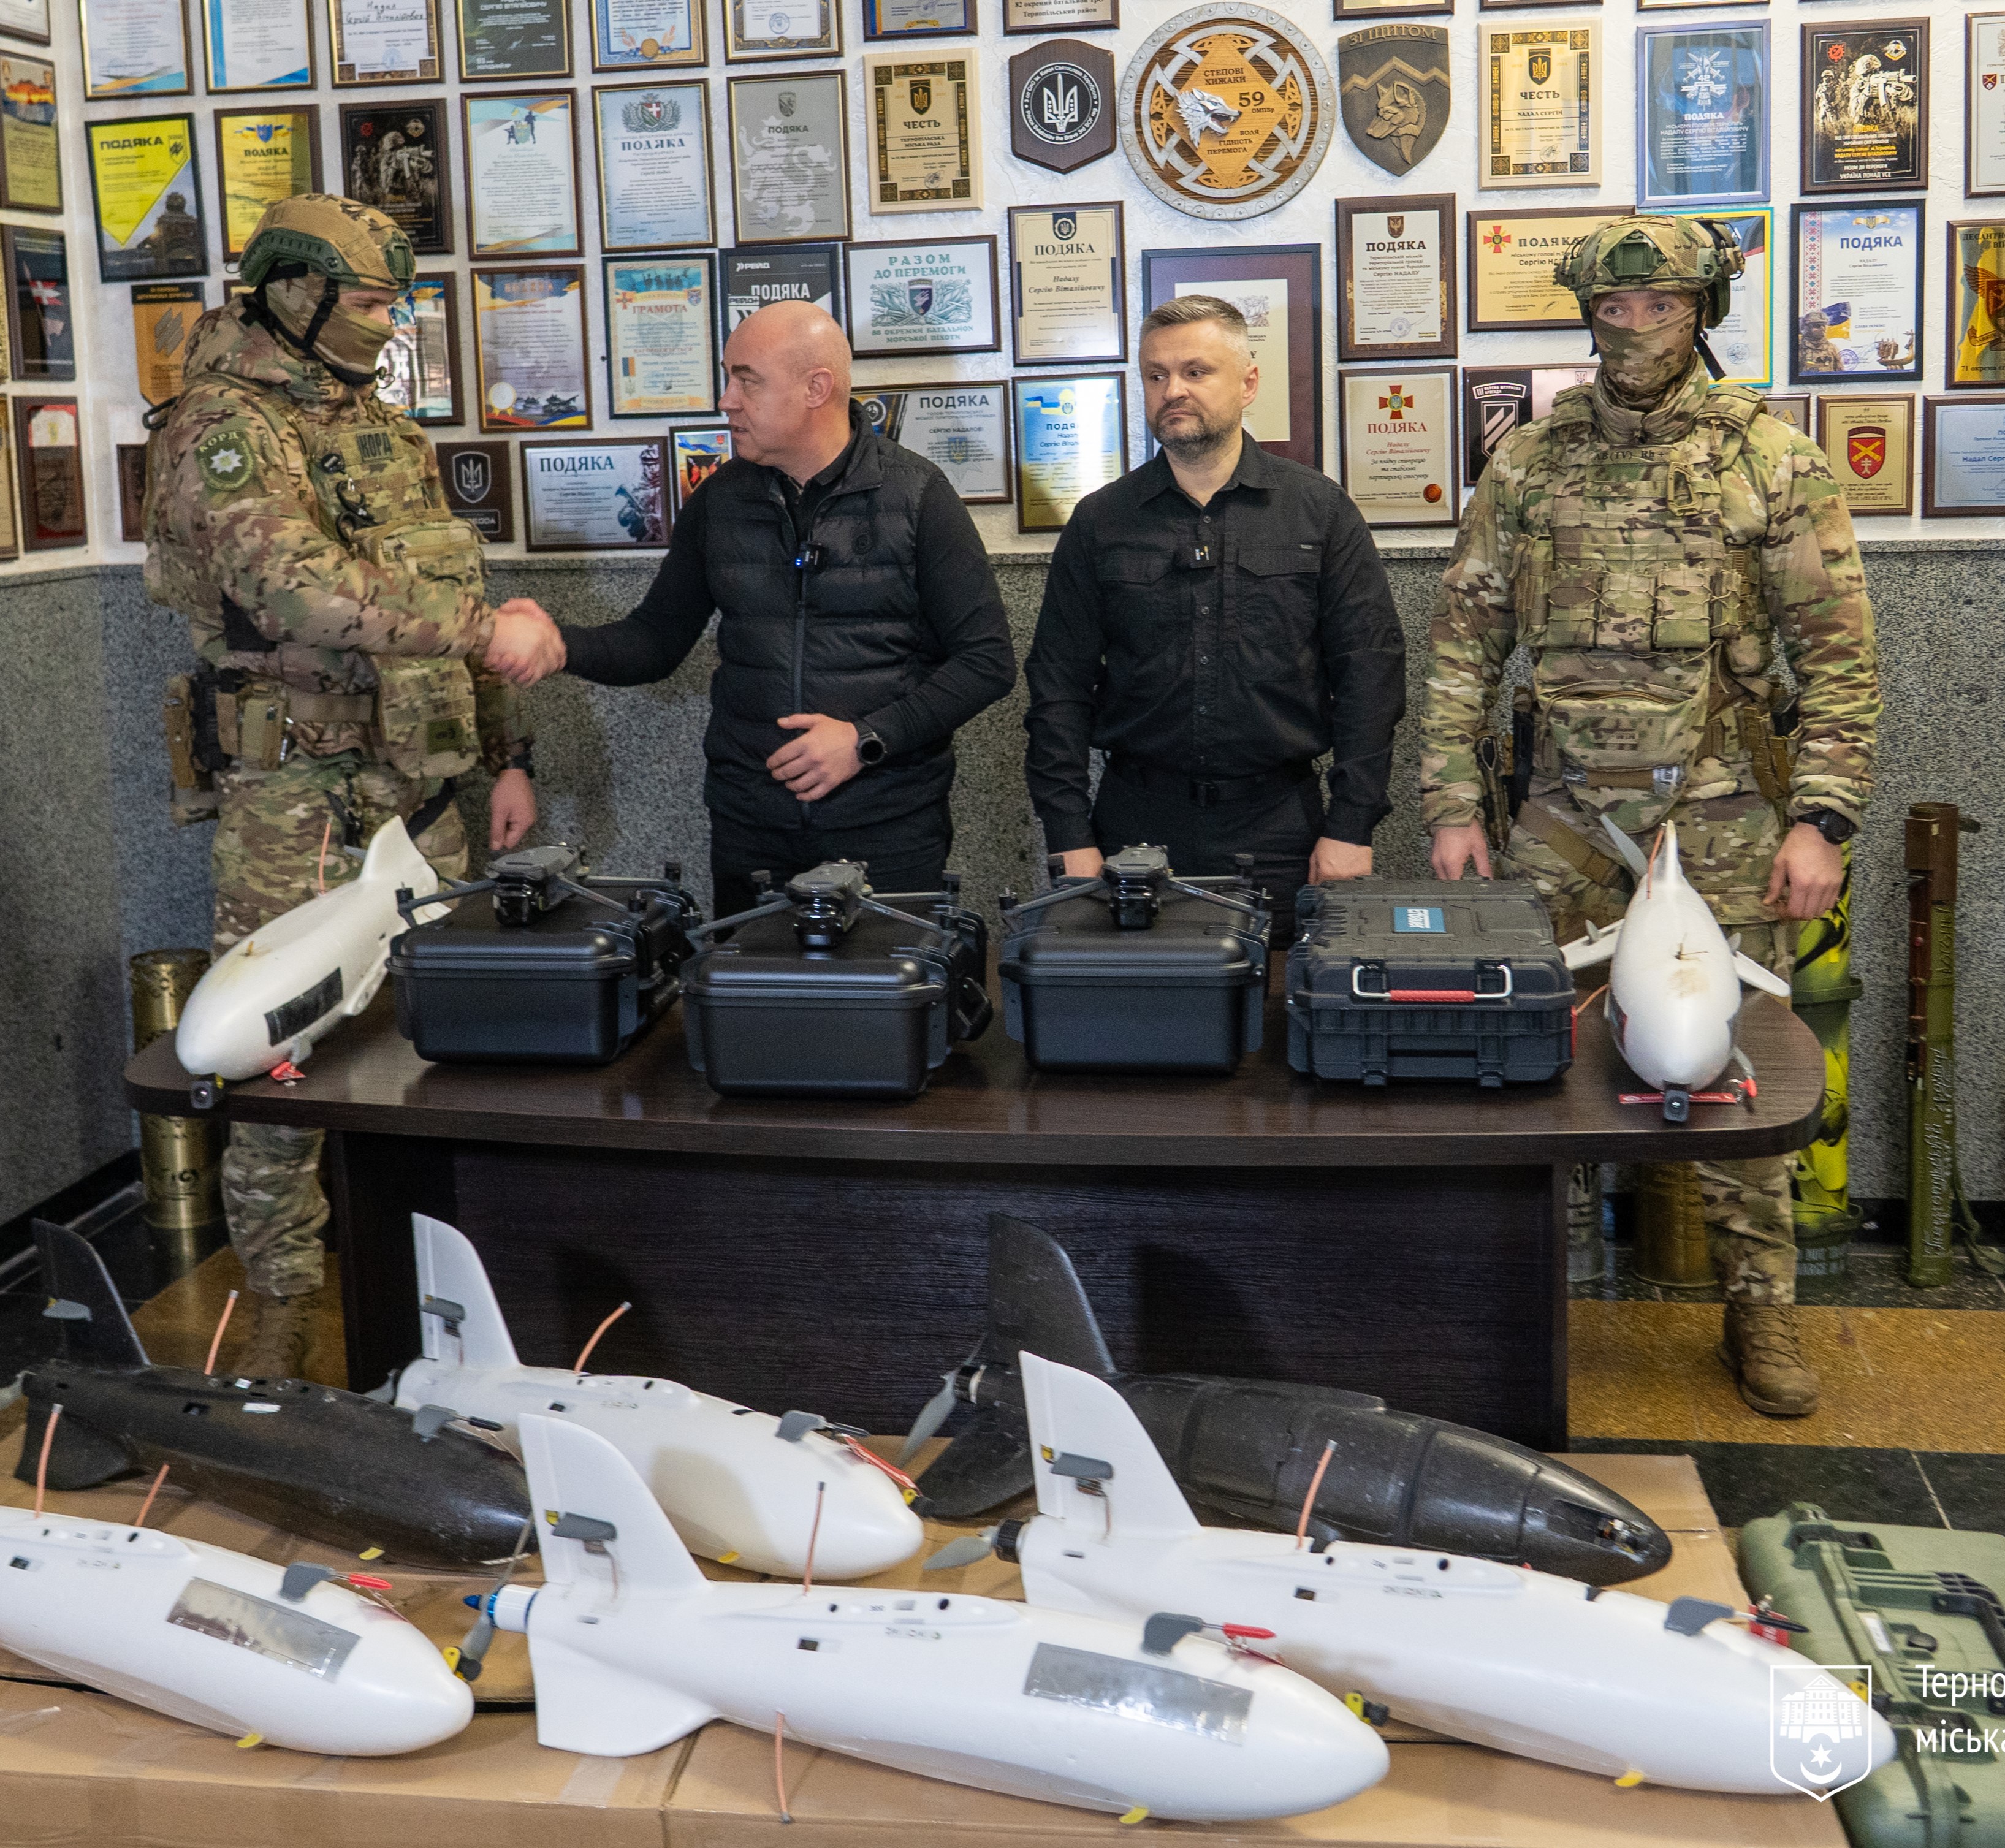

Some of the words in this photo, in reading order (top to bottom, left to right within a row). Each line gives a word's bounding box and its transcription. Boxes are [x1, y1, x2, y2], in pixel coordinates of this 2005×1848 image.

[1023, 9, 1076, 18] Тернопільський
[1349, 33, 1364, 46] ЗІ
[1368, 25, 1437, 40] ЩИТОМ
[1204, 67, 1244, 77] СТЕПОВІ
[1204, 76, 1246, 85] ХИЖАКИ
[1239, 91, 1265, 107] 59
[1520, 91, 1561, 100] ЧЕСТЬ
[1684, 112, 1725, 121] ПОДЯКА
[768, 125, 809, 134] ПОДЯКА
[904, 120, 941, 129] ЧЕСТЬ
[100, 136, 164, 150] ПОДЯКА
[621, 138, 686, 151] ПОДЯКА
[243, 147, 289, 157] ПОДЯКА
[1366, 241, 1426, 253] ПОДЯКА
[1518, 237, 1581, 248] ПОДЯКА
[1840, 236, 1903, 251] ПОДЯКА
[1035, 243, 1095, 256] ПОДЯКА
[889, 254, 951, 266] РАЗОМ
[874, 269, 891, 279] ДО
[895, 265, 966, 278] ПЕРЕМОГИ
[751, 283, 811, 301] ПОДЯКА
[633, 304, 688, 314] ГРАМОТА
[919, 395, 990, 409] ПОДЯКА
[1368, 422, 1428, 434] ПОДЯКА
[540, 456, 615, 474] ПОДЯКА
